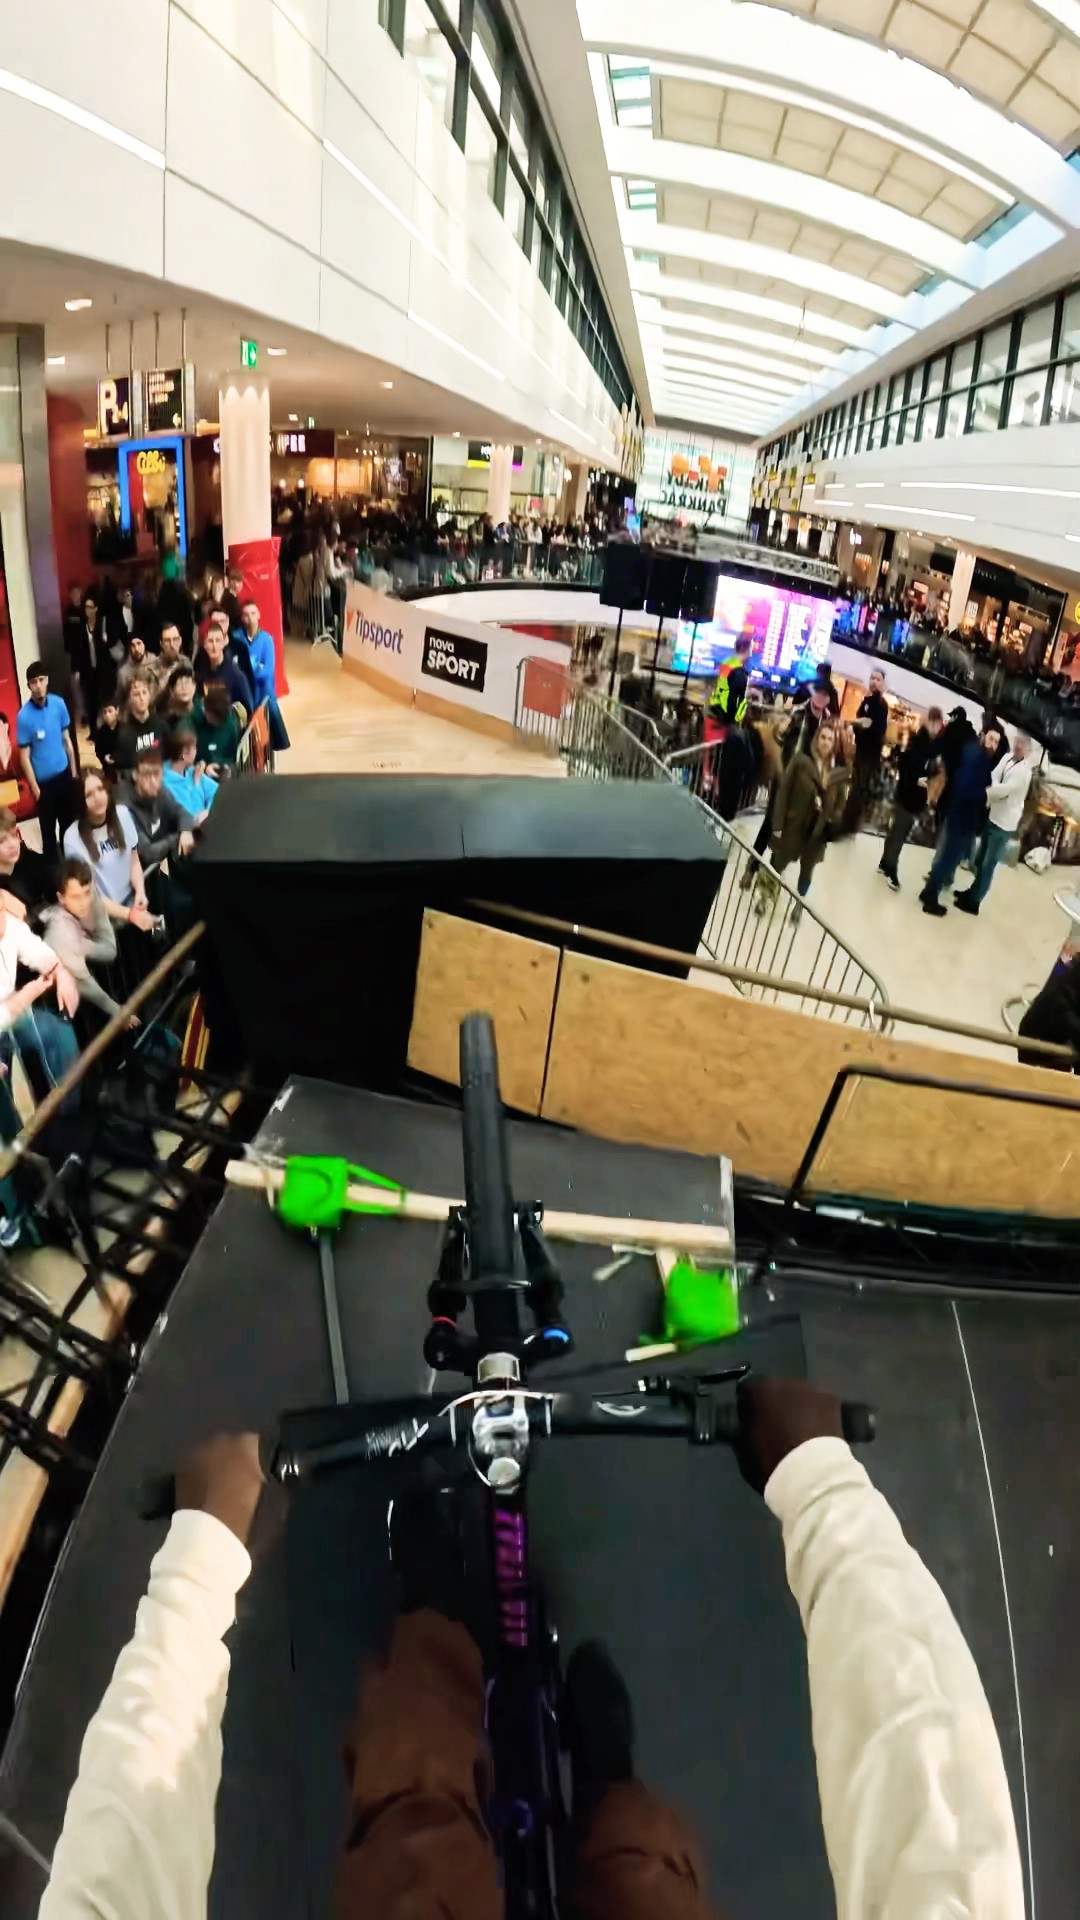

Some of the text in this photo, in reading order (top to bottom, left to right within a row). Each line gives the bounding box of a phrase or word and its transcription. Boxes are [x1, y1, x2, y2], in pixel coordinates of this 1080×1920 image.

[355, 610, 404, 655] Tipsport
[429, 636, 455, 653] nova
[427, 650, 480, 681] SPORT
